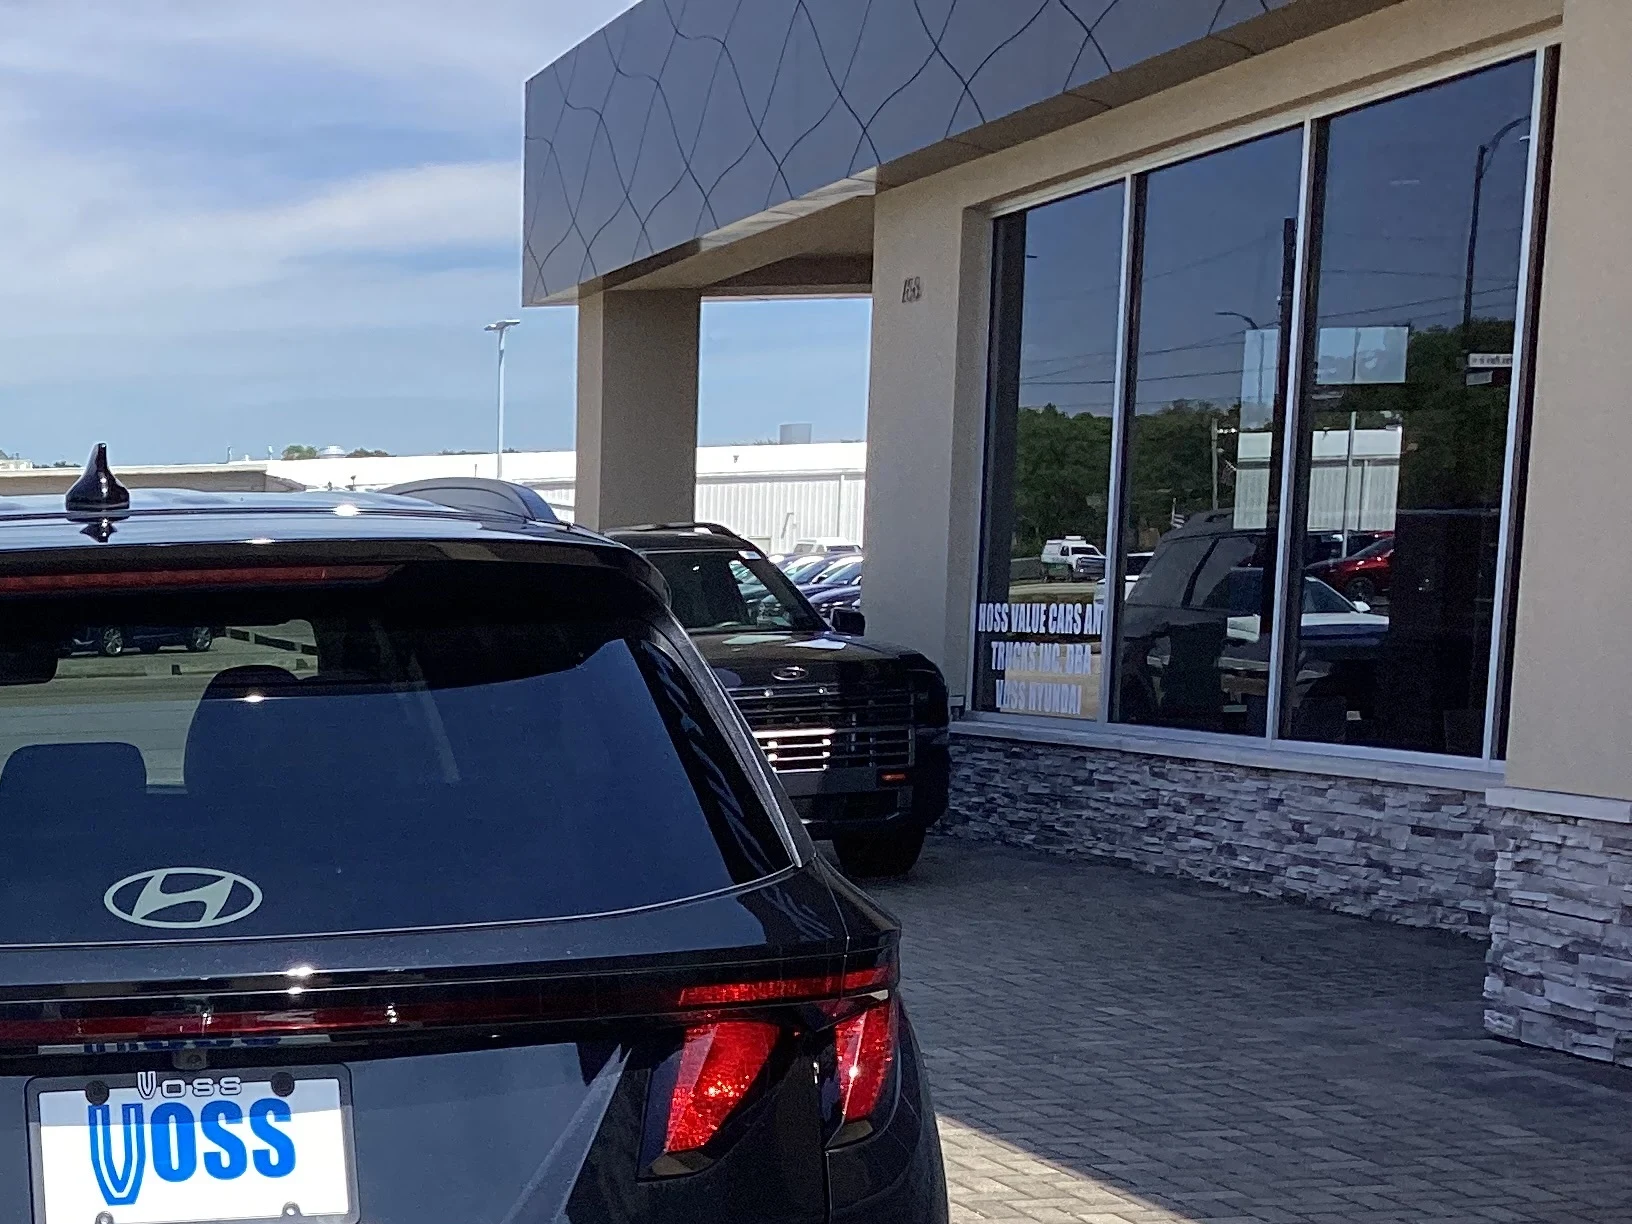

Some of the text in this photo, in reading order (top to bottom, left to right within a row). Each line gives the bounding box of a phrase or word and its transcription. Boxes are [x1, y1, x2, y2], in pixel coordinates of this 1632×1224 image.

[1011, 603, 1047, 634] VALUE
[1048, 602, 1082, 635] CARS
[991, 641, 1036, 671] TRUCKS
[1028, 682, 1082, 716] HYUNDAI
[88, 1098, 296, 1206] VOSS
